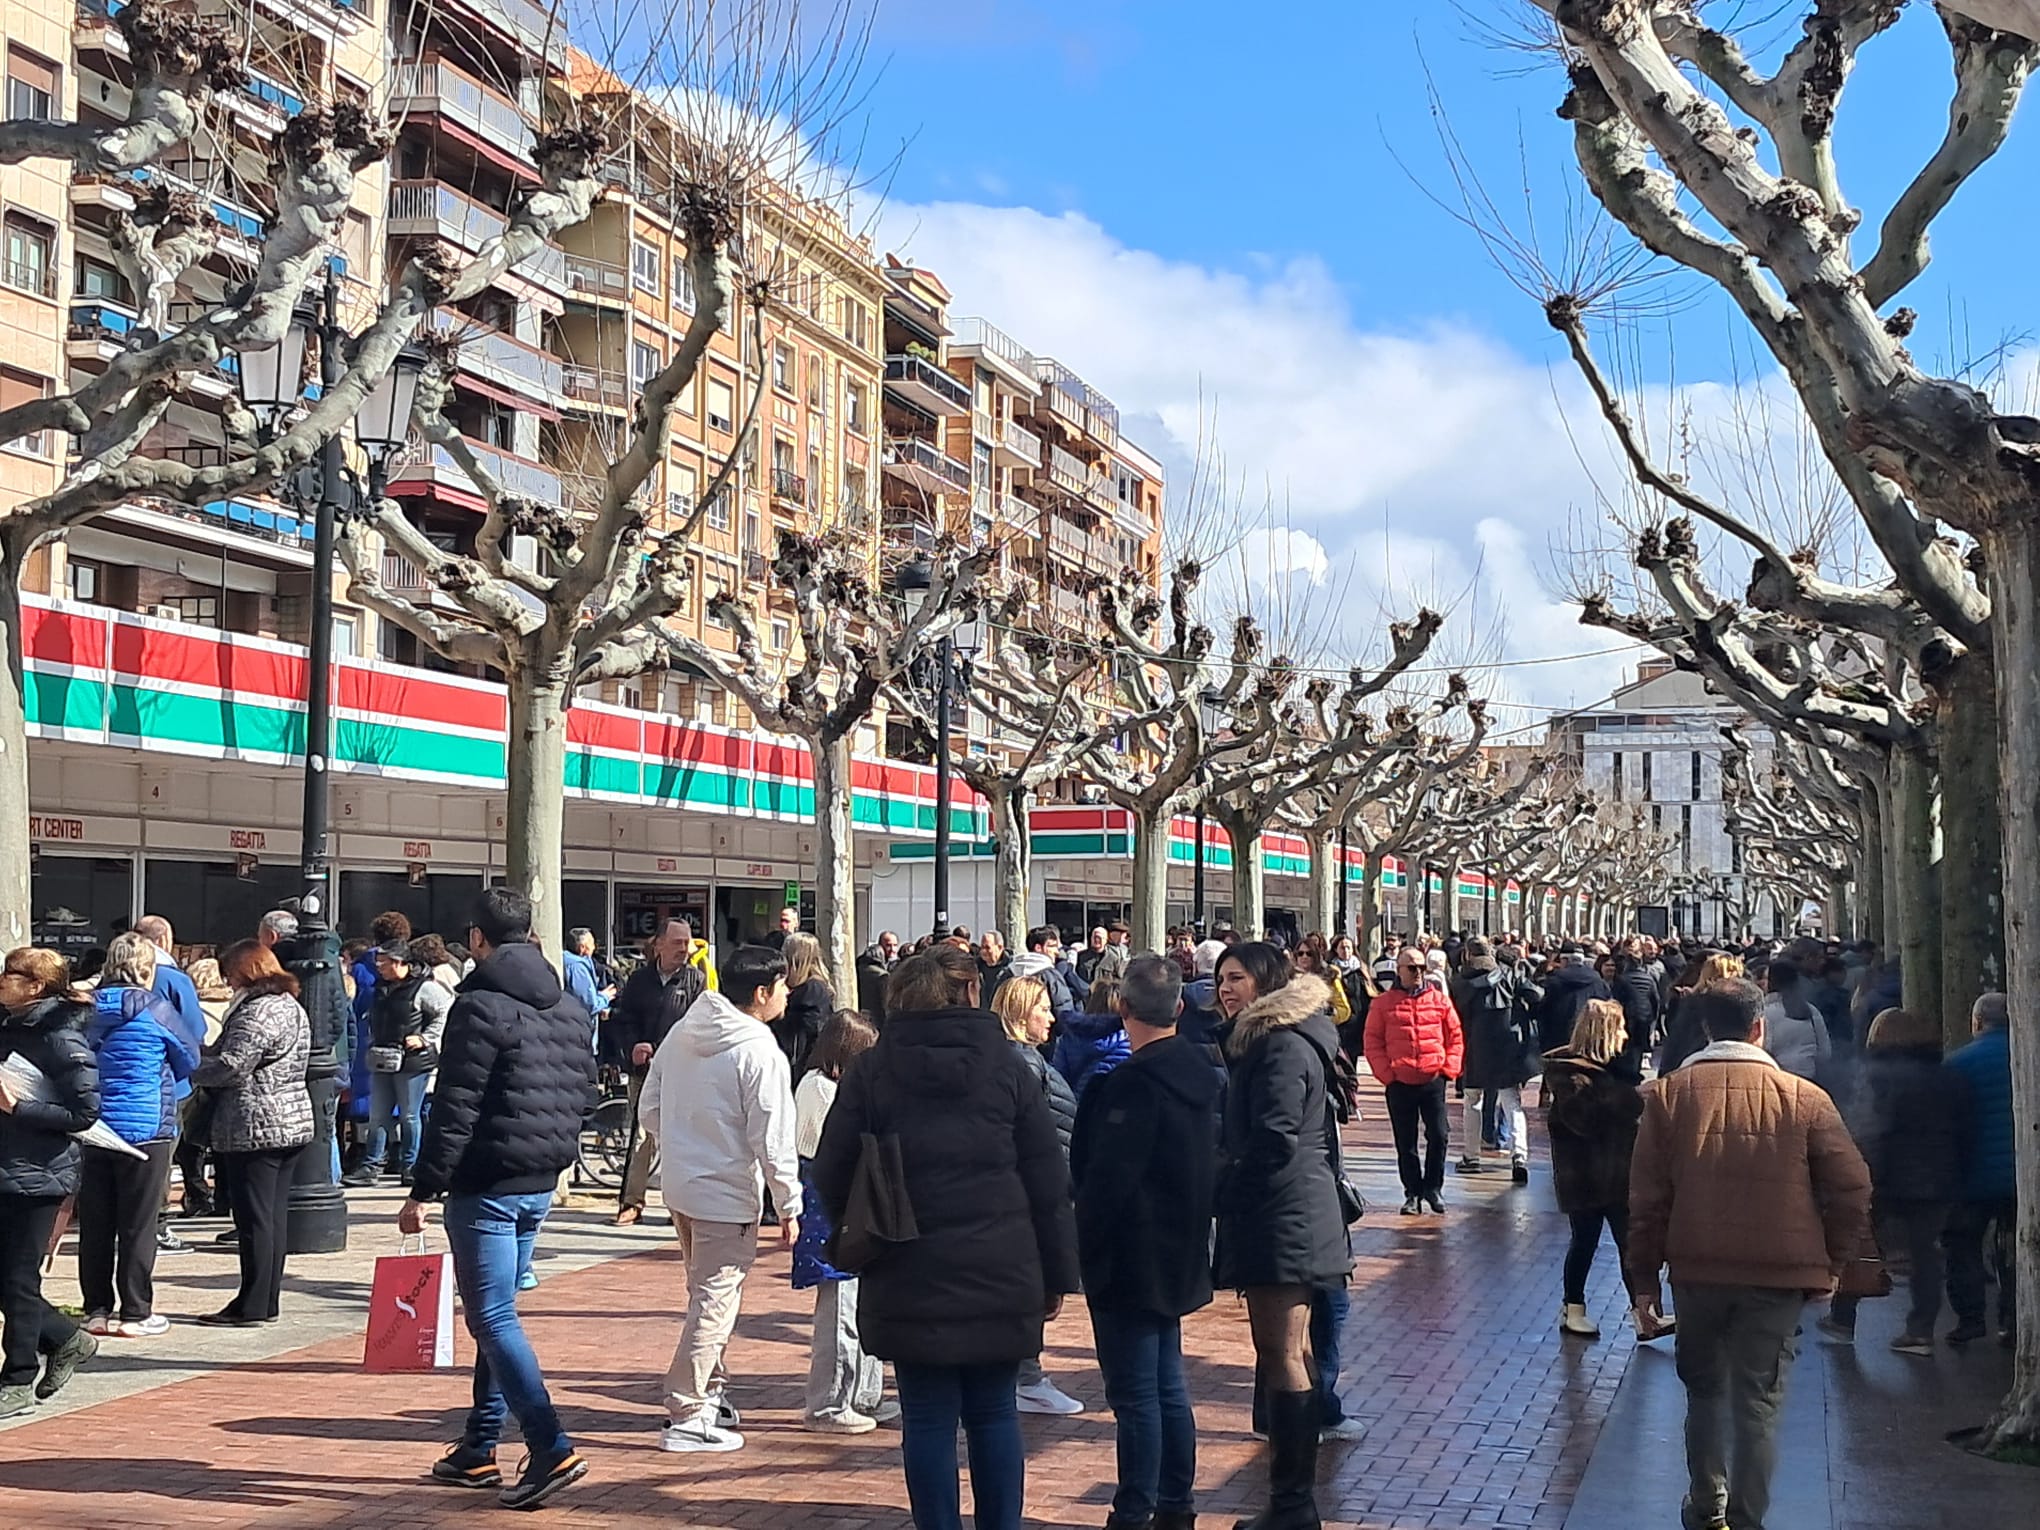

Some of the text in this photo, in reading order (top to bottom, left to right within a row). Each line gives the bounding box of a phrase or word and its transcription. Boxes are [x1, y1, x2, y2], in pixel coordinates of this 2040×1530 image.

[151, 785, 160, 799] 4
[344, 803, 352, 816] 5
[44, 817, 83, 840] CENTER
[496, 816, 504, 828] 6
[230, 830, 267, 849] REGATTA
[618, 828, 625, 838] 7
[626, 911, 657, 935] 1€
